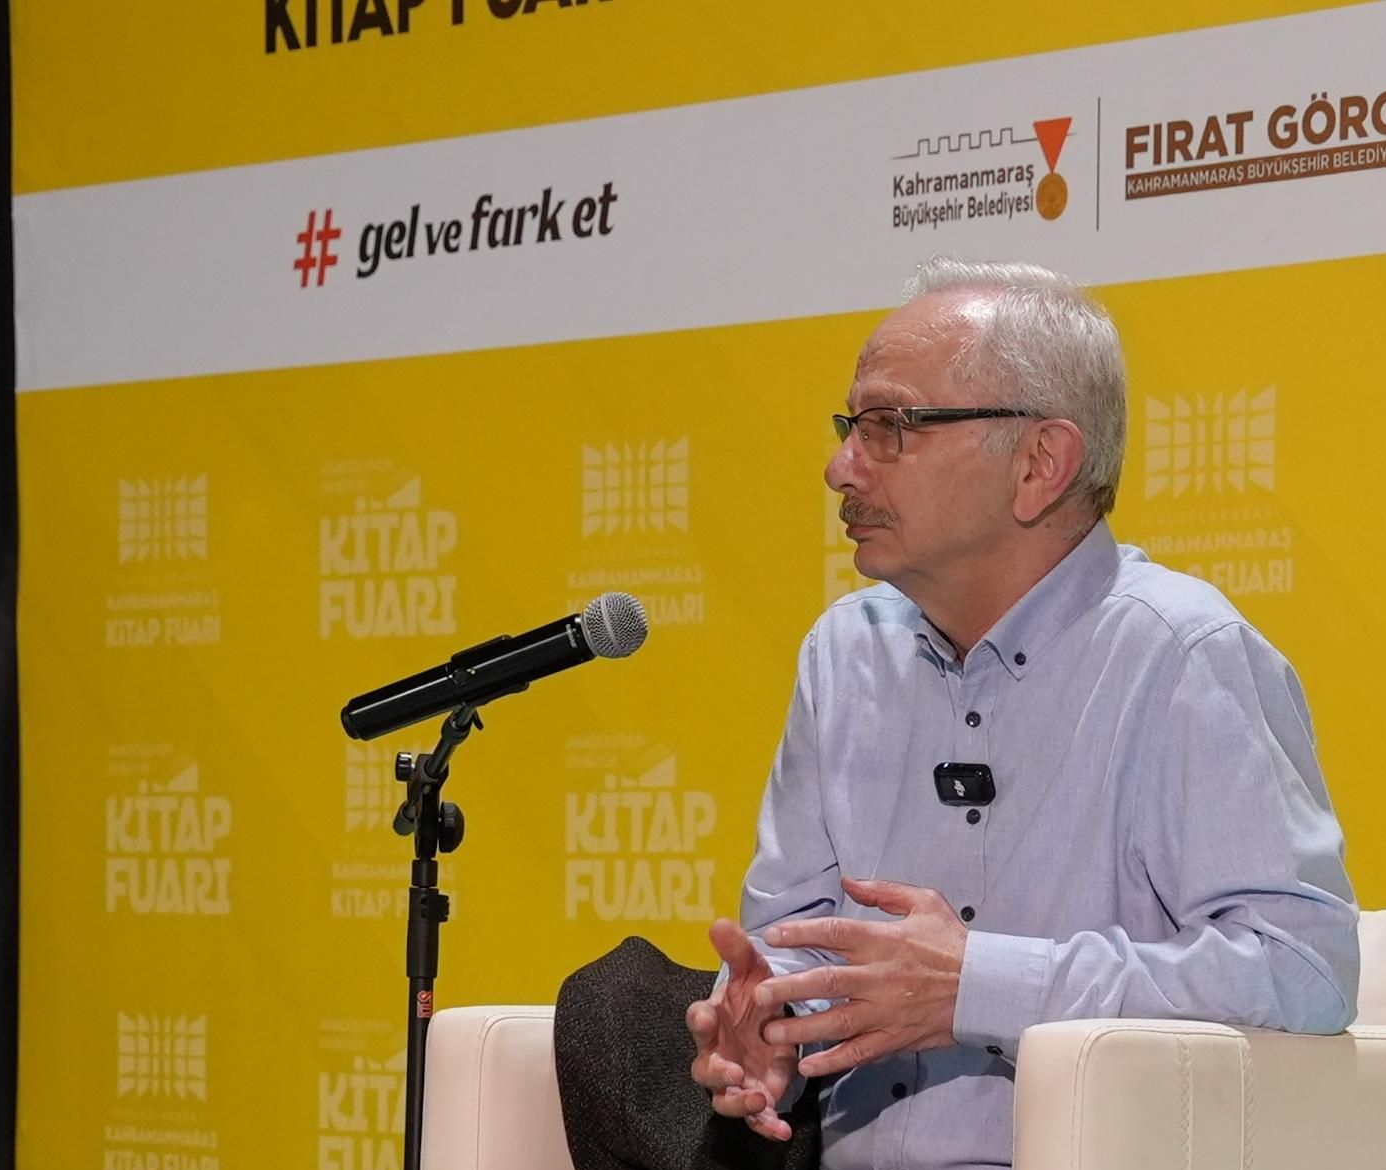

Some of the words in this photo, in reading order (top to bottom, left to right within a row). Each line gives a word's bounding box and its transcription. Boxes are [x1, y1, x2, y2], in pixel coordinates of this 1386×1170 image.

[1126, 110, 1254, 169] FIRAT
[892, 163, 1035, 199] Kahramanmaraş
[1127, 165, 1245, 195] KAHRAMANMARAŞ
[1247, 155, 1330, 180] BÜYÜKŞEHİR
[356, 203, 421, 279] gel
[425, 219, 463, 256] ve
[469, 186, 566, 251] fark
[572, 181, 618, 238] et
[892, 199, 964, 232] Büyükşehir
[967, 188, 1035, 220] Belediyesi
[319, 573, 459, 641] FUARI
[106, 855, 233, 917] FUARI
[565, 858, 715, 921] FUARI
